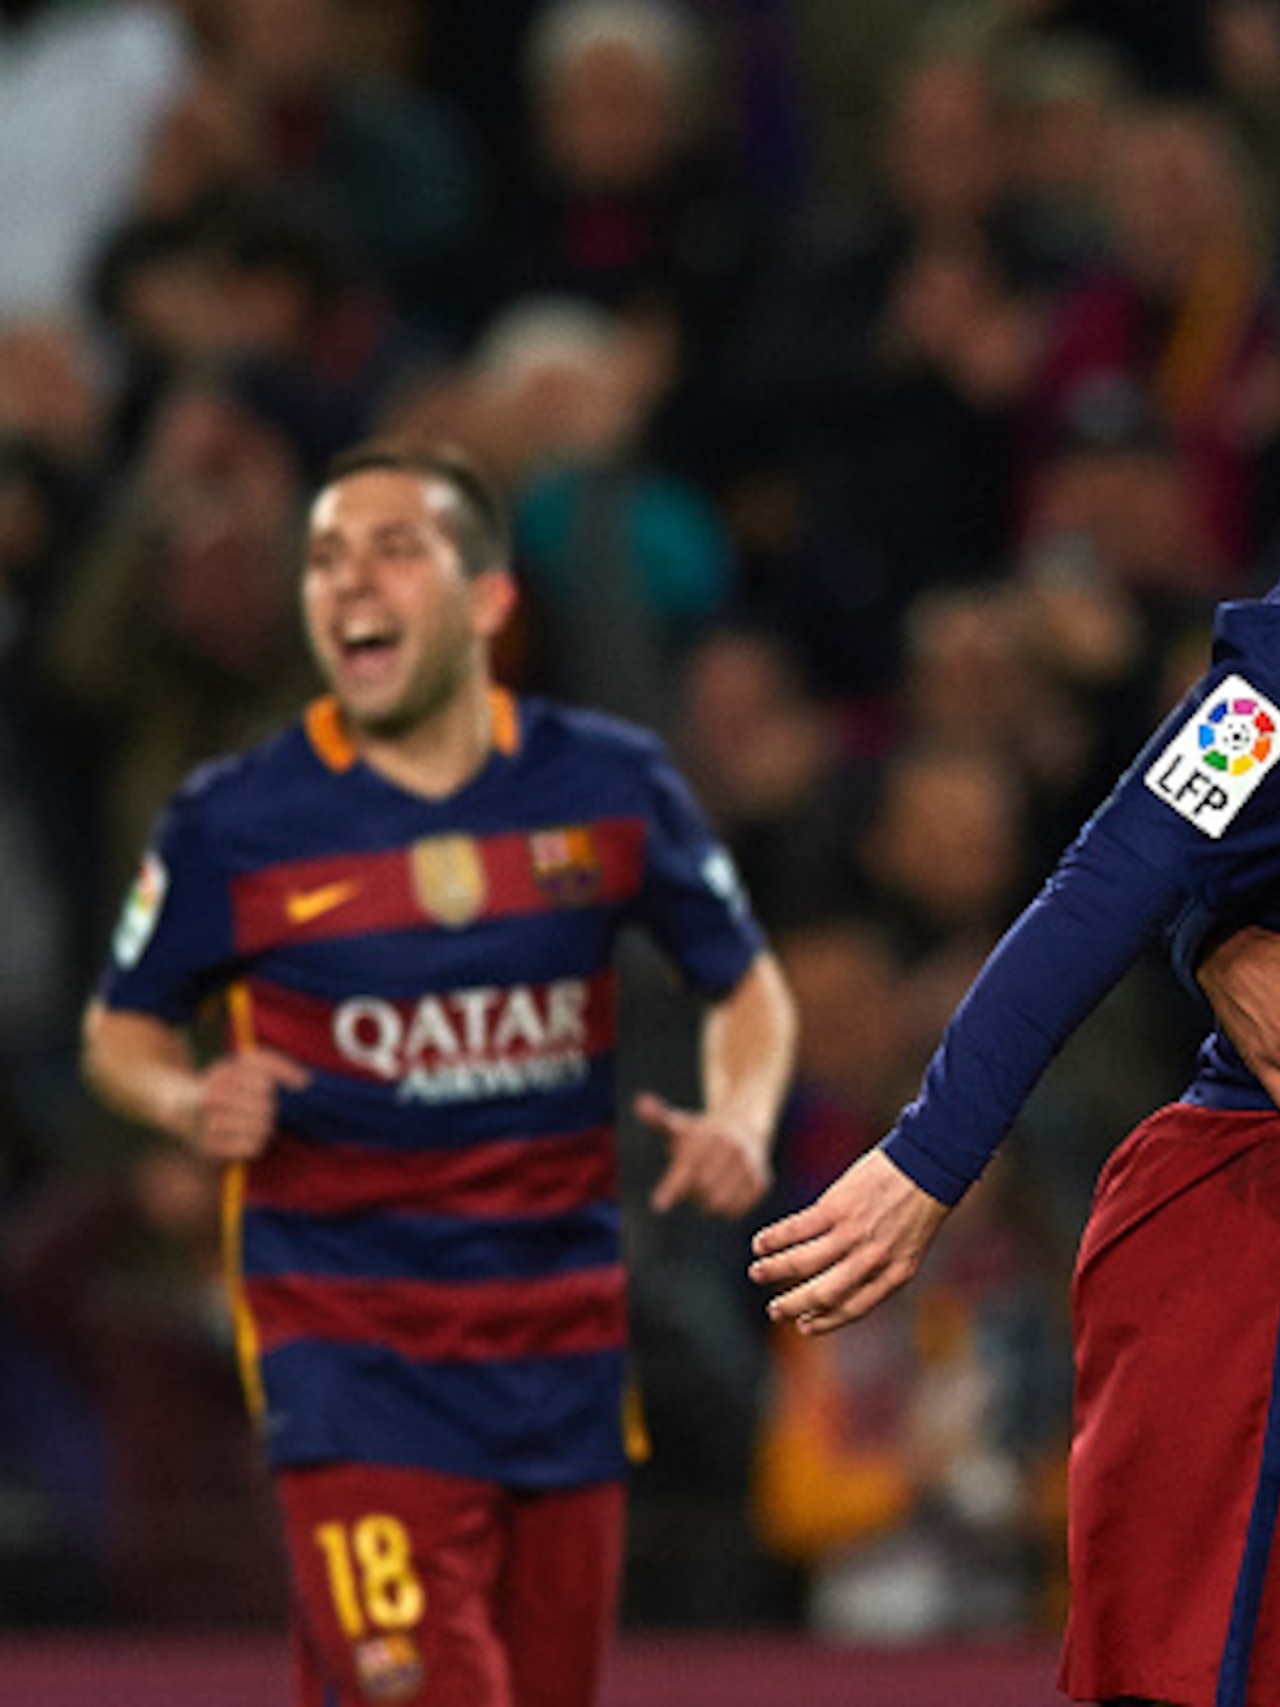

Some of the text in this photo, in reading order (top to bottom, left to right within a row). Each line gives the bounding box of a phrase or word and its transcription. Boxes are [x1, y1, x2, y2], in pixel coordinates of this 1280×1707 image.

[1158, 756, 1229, 815] LFP
[334, 977, 588, 1079] QATAR
[315, 1513, 425, 1640] 18
